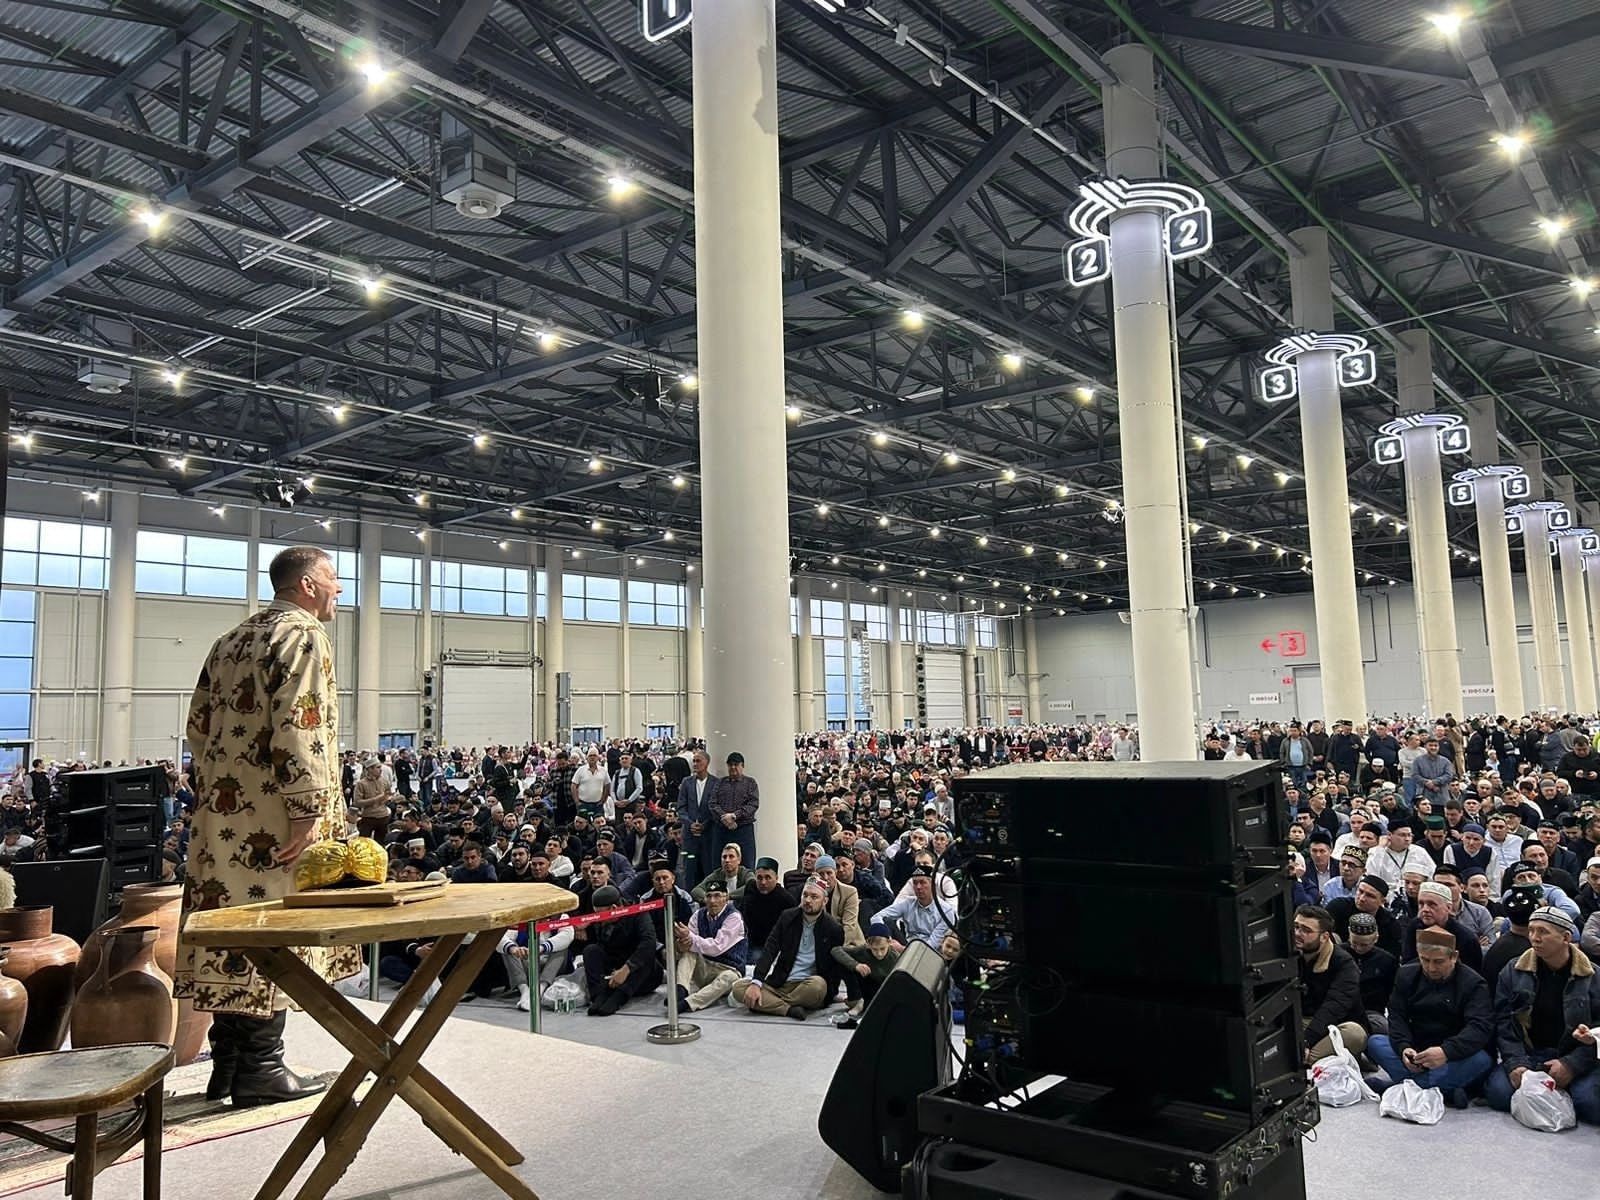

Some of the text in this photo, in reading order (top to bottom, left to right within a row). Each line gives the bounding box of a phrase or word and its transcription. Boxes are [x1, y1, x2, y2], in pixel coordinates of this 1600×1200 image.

[1178, 218, 1199, 248] 2
[1080, 248, 1098, 276] 2
[1349, 358, 1365, 379] 3
[1271, 374, 1286, 394] 3
[1447, 431, 1462, 448] 4
[1383, 442, 1397, 458] 4
[1456, 486, 1468, 501] 5
[1511, 479, 1523, 494] 5
[1507, 518, 1517, 530] 6
[1554, 513, 1565, 525] 6
[1584, 538, 1594, 549] 7
